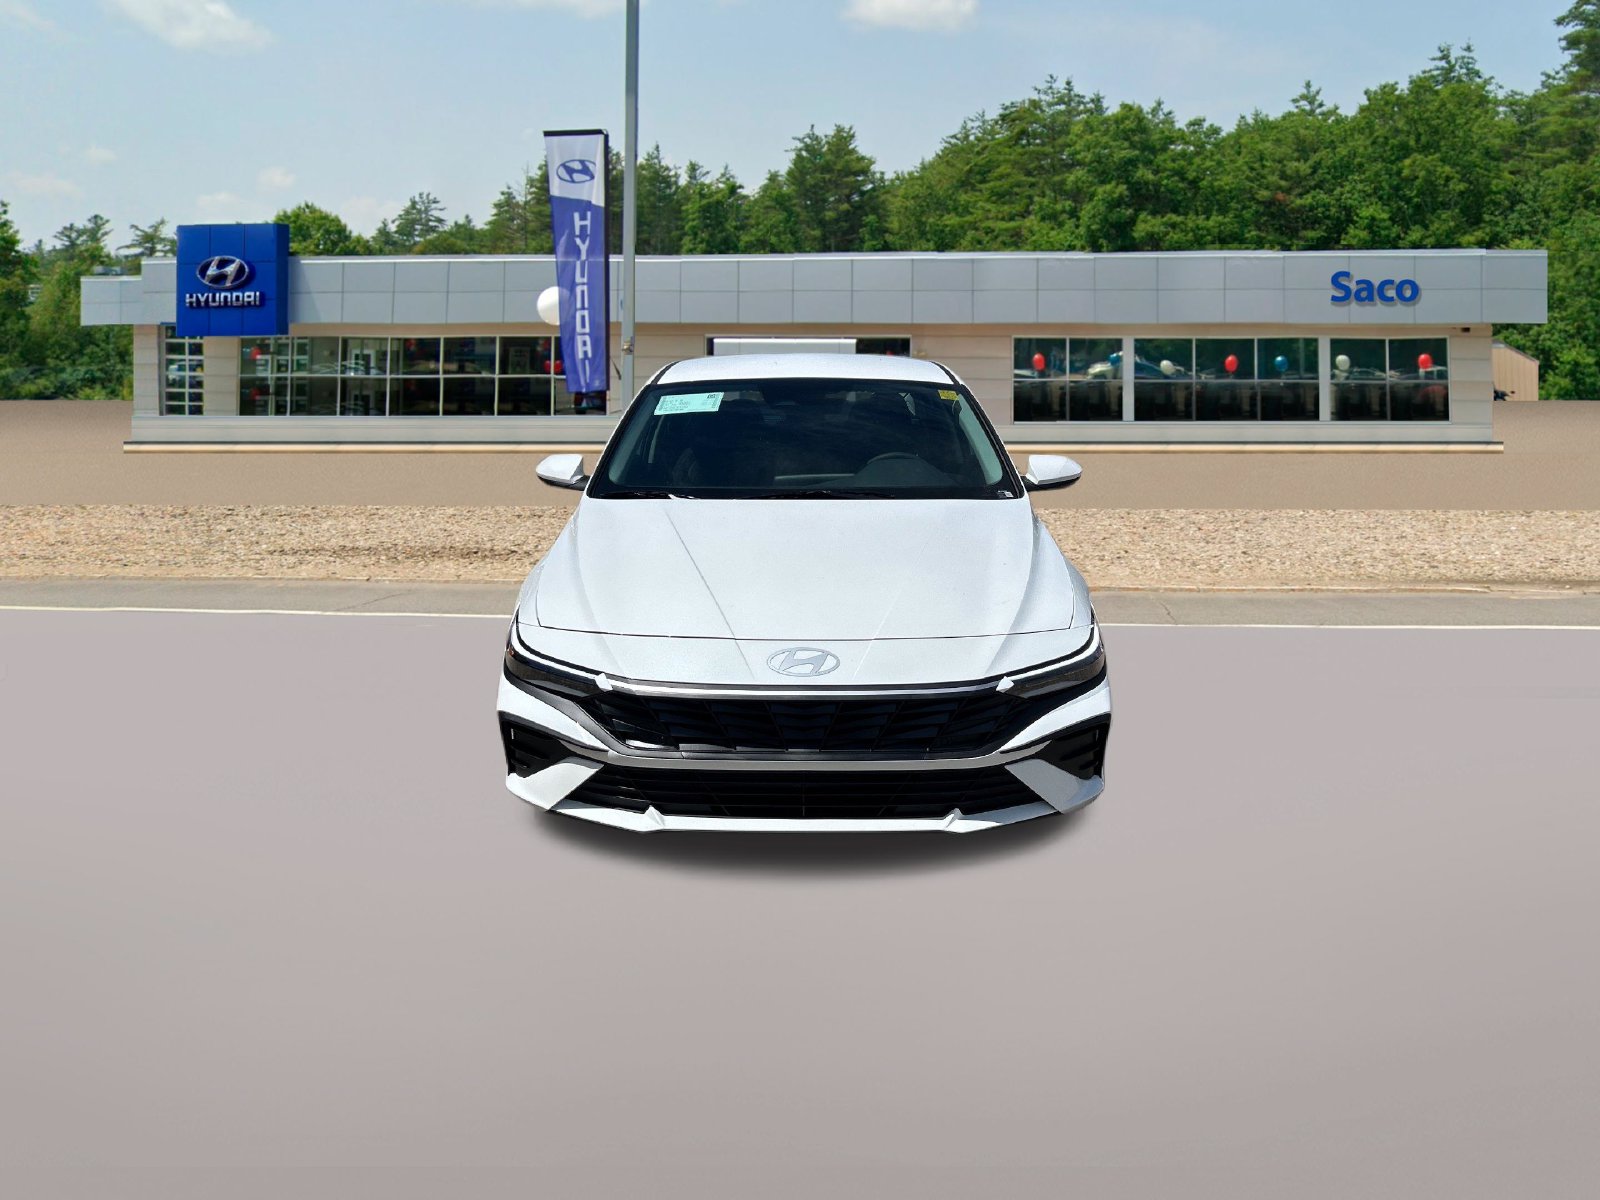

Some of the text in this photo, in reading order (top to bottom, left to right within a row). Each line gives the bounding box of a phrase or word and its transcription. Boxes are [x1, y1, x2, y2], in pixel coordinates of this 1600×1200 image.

[185, 291, 260, 307] HYUNDAI
[573, 211, 592, 383] HYUNDAI
[1331, 271, 1419, 302] Saco
